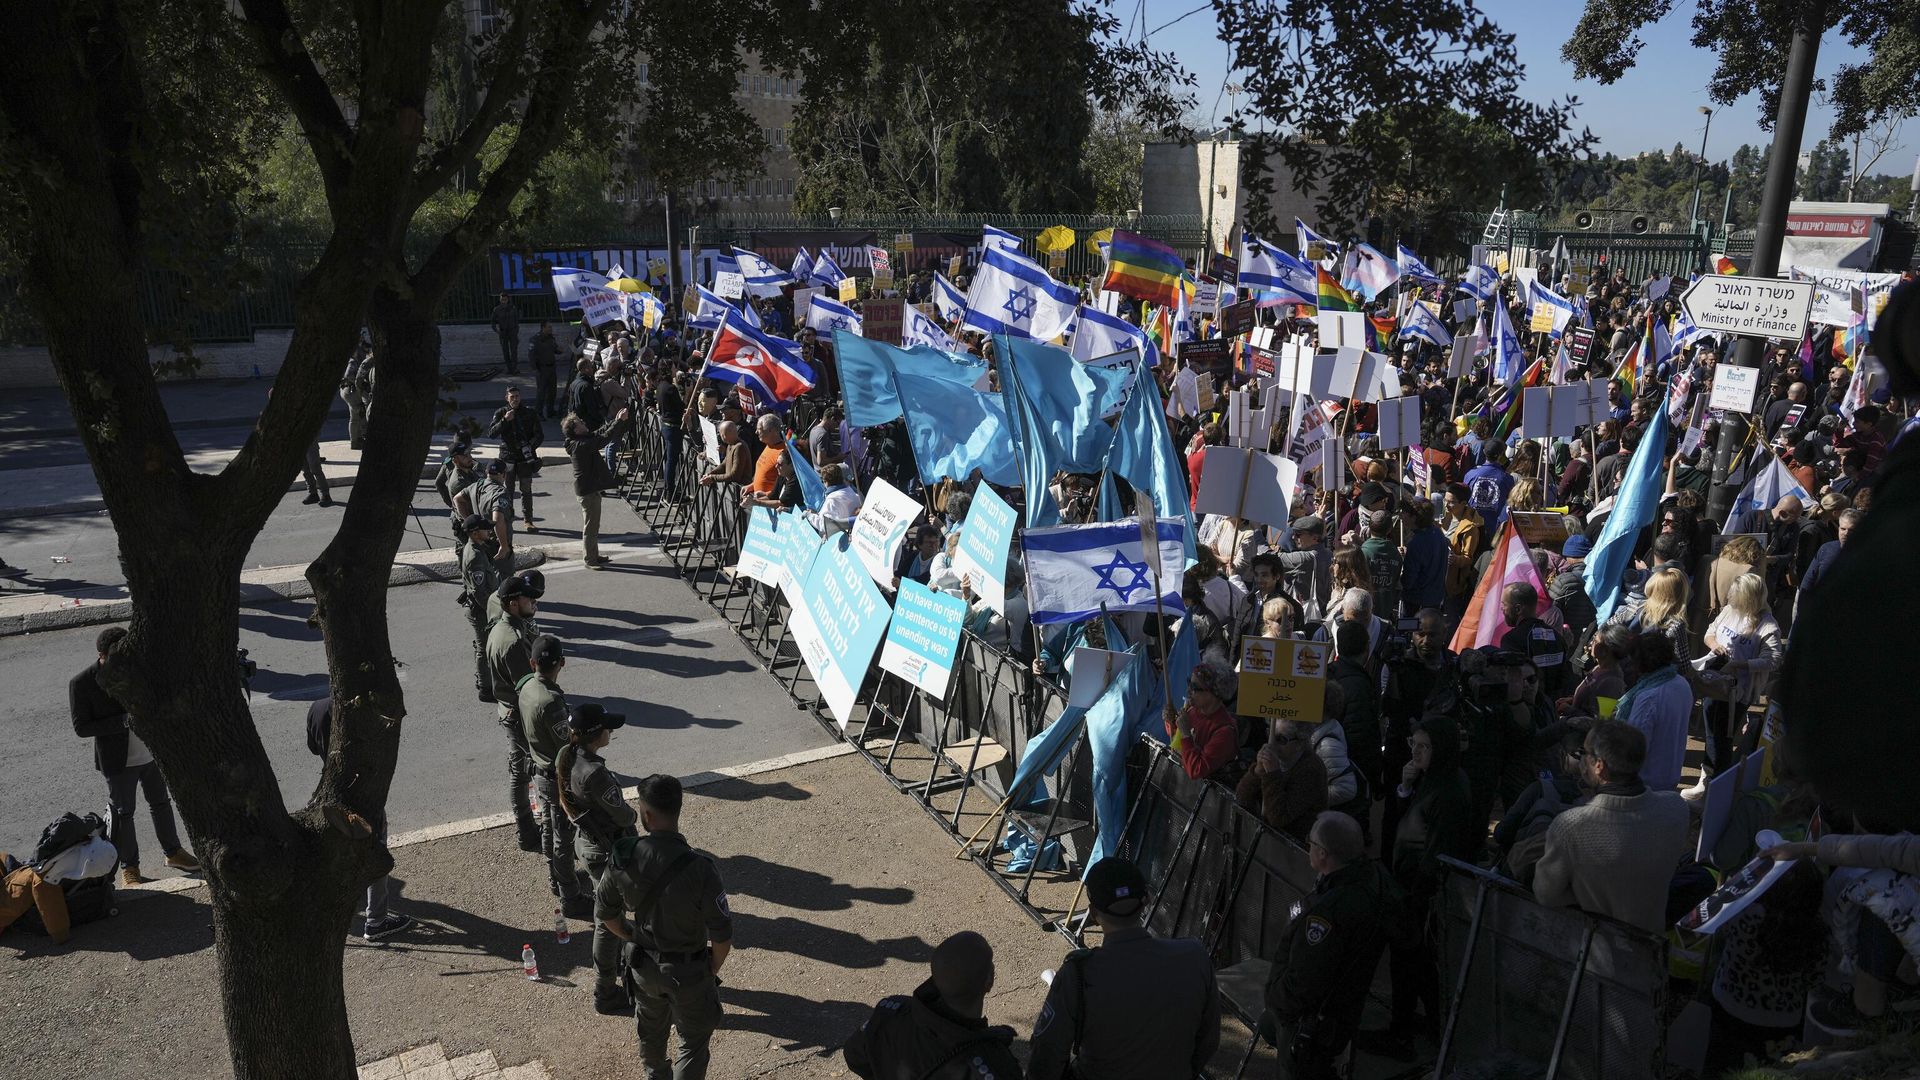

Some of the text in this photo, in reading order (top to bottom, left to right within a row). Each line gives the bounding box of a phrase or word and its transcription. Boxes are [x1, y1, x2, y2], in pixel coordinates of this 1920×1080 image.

[1714, 283, 1751, 296] האוצר
[1757, 287, 1795, 300] משרד
[1714, 298, 1788, 318] وزارة المالية
[1701, 311, 1797, 332] Ministry of Finance
[845, 566, 862, 597] לכם
[823, 568, 860, 636] לדון אותנו
[858, 590, 876, 619] אין
[900, 586, 962, 623] You have no right
[813, 594, 848, 659] למלחמות
[896, 604, 957, 641] to sentence us to
[896, 624, 949, 658] unending wars
[1267, 677, 1296, 688] סכנה
[1268, 691, 1292, 703] خطر
[1259, 705, 1300, 718] Danger
